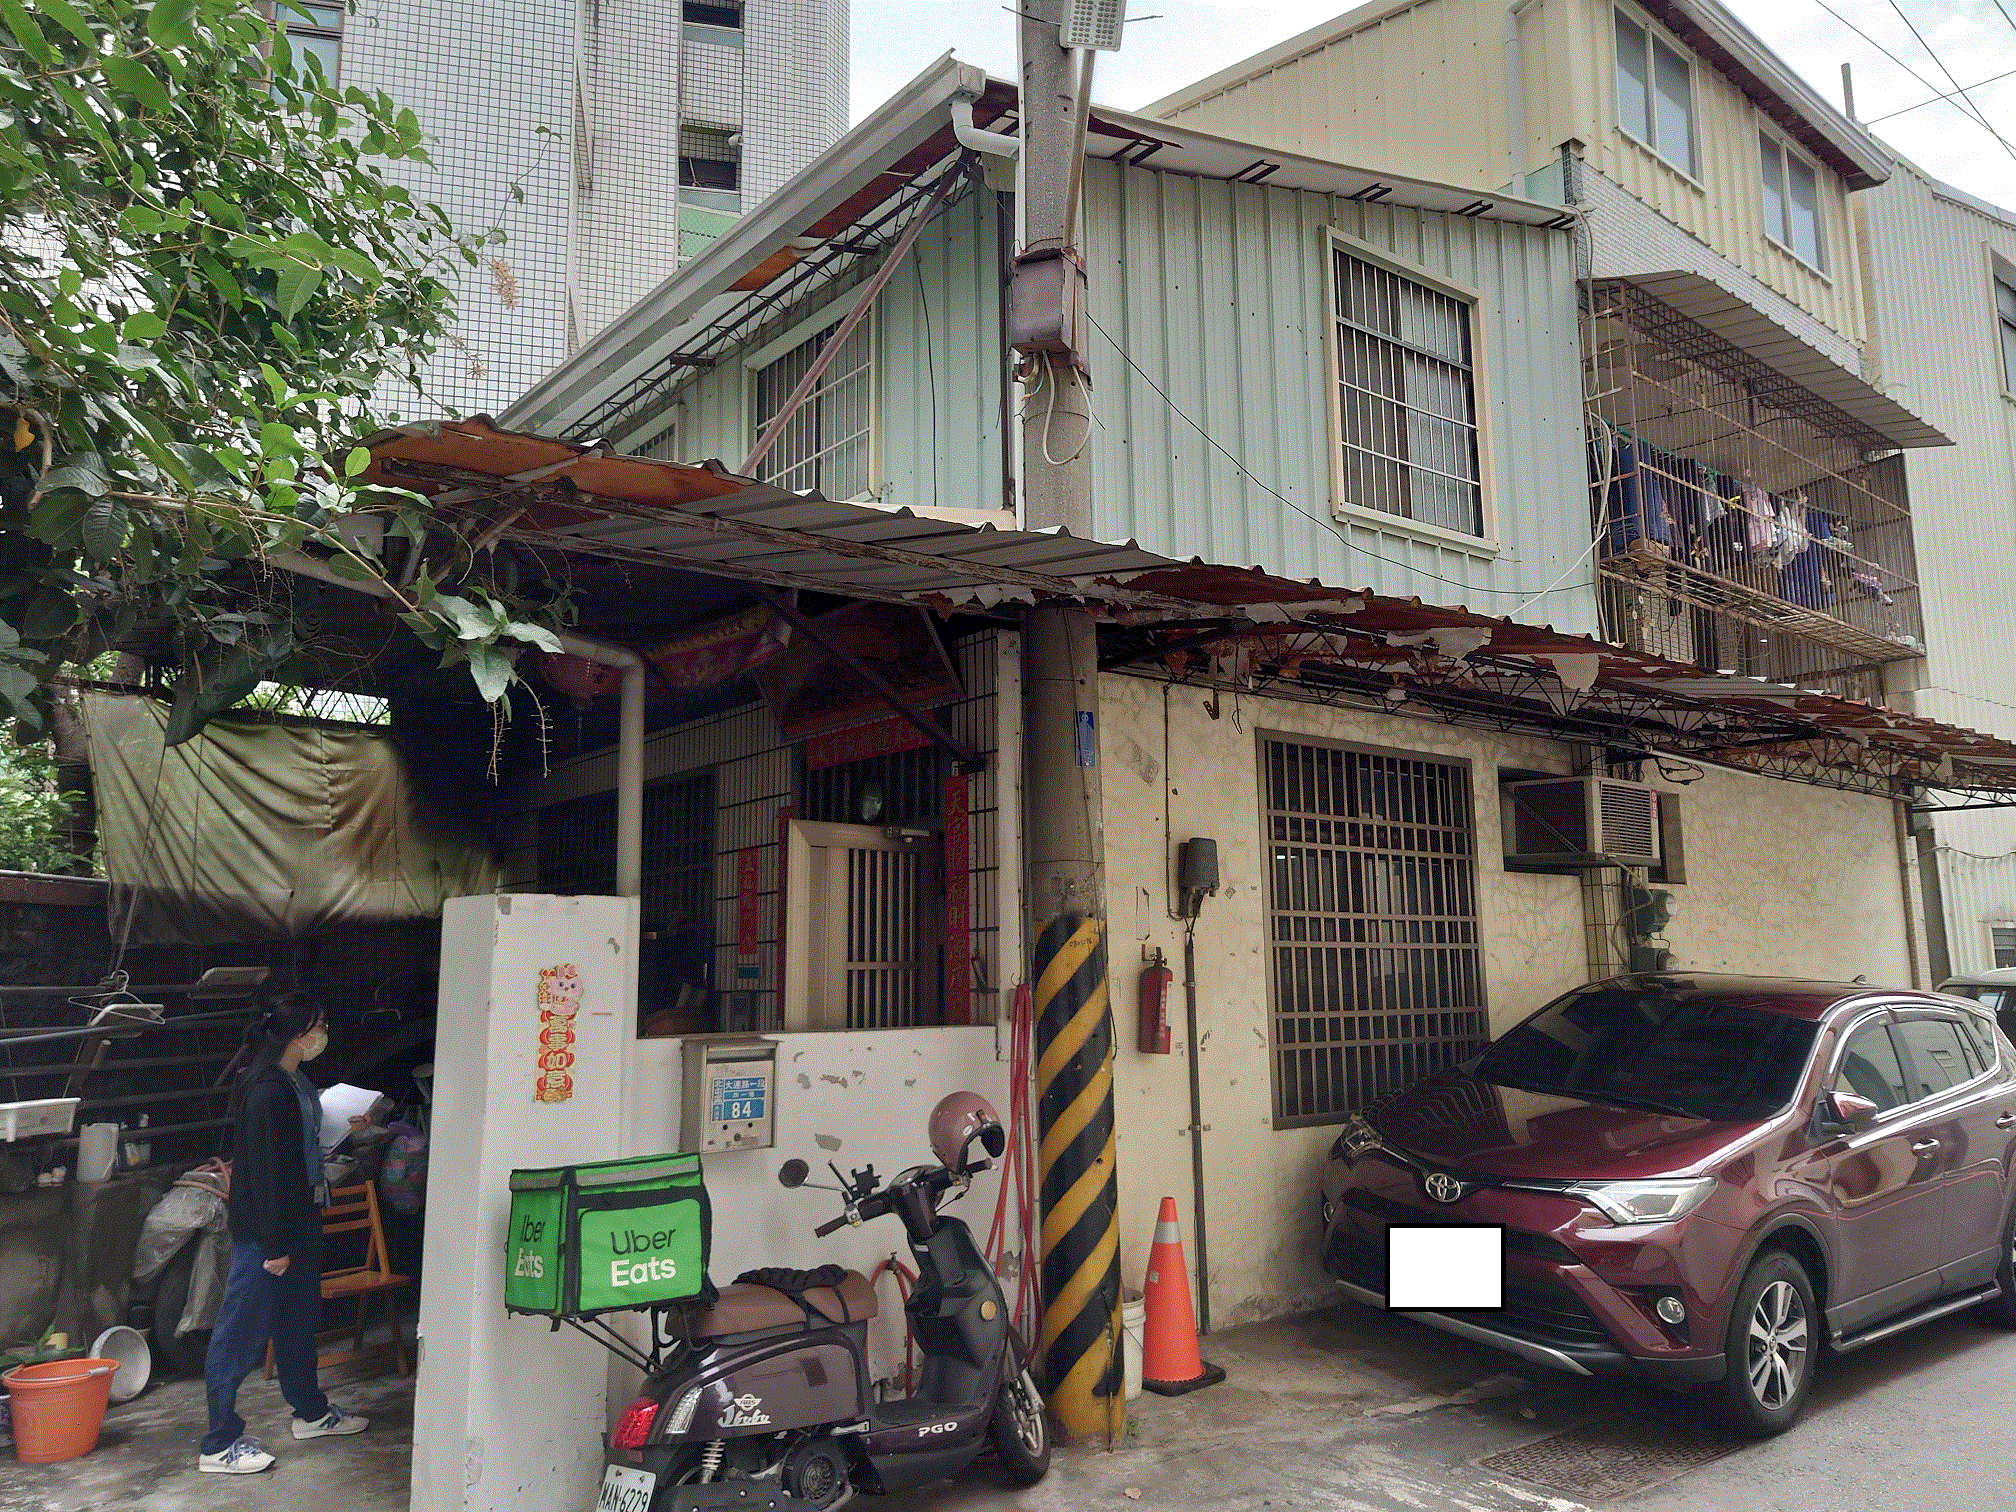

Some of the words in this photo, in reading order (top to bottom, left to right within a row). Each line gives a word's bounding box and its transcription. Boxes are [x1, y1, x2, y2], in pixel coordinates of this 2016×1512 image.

[731, 1101, 752, 1119] 84
[611, 1227, 676, 1255] Uber
[611, 1257, 676, 1287] Eats
[918, 1421, 958, 1438] PGO
